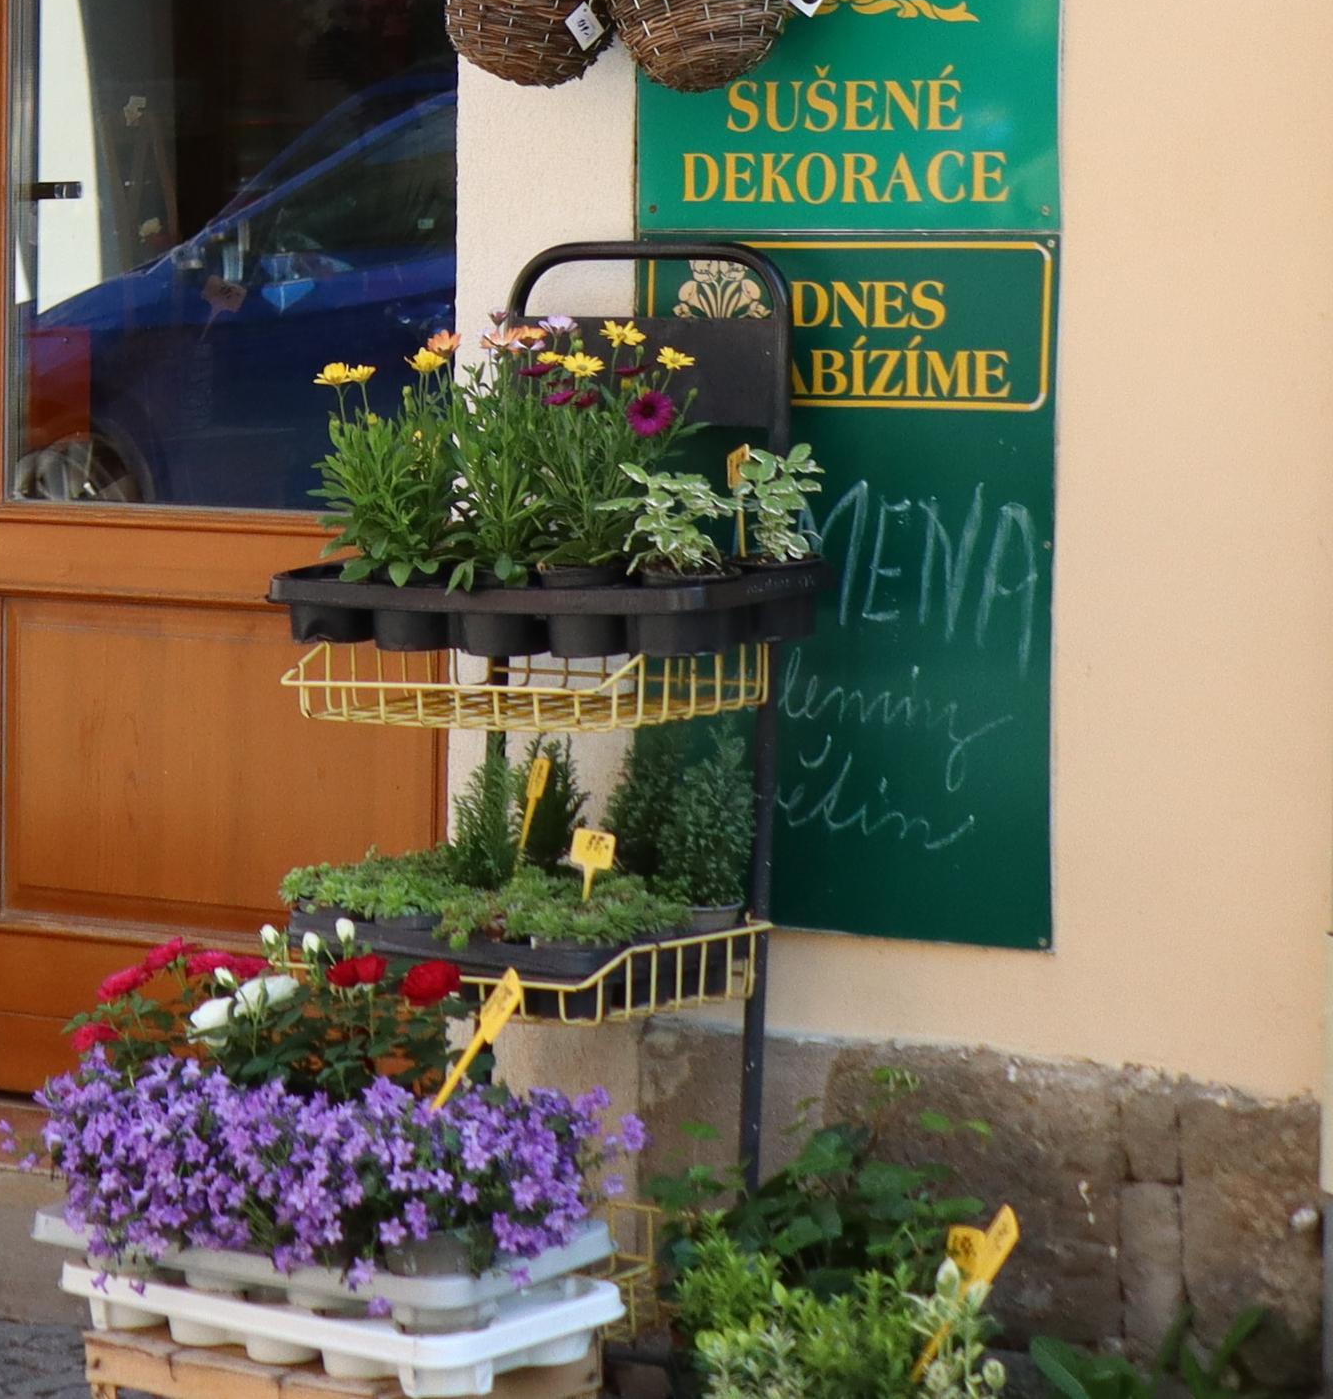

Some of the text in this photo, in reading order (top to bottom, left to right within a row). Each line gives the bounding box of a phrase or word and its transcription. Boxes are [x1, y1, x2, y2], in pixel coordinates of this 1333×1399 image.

[726, 65, 962, 132] SUŠENÉ
[682, 151, 1009, 203] DEKORACE
[790, 280, 946, 330] DNES
[791, 335, 1012, 397] BÍZÍME
